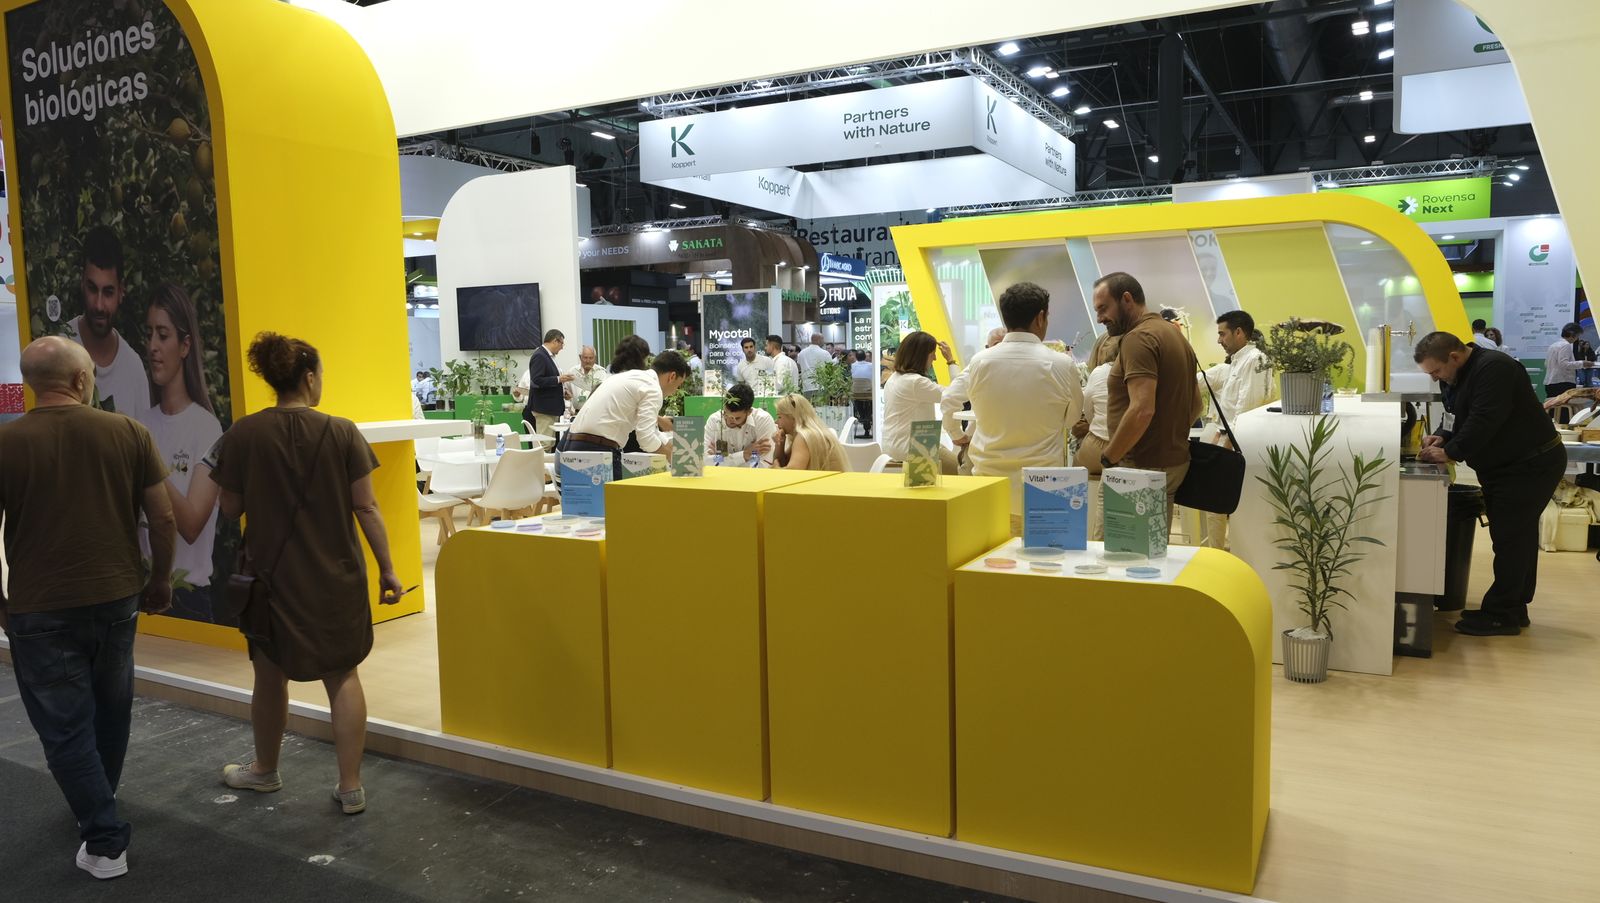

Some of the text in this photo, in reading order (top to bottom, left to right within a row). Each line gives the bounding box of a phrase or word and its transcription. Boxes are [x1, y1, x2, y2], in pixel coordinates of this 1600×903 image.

[22, 21, 156, 82] Soluciones
[25, 72, 148, 126] biológicas
[843, 107, 909, 124] Partners
[843, 120, 931, 140] with Nature
[671, 160, 696, 169] Koppert
[758, 175, 791, 197] Koppert
[1422, 193, 1476, 204] Rovensa
[1422, 204, 1454, 214] Next
[796, 223, 895, 246] Restaura
[681, 238, 723, 250] SAKATA
[583, 248, 600, 259] your
[601, 246, 629, 256] NEEDS
[828, 286, 857, 302] FRUTA
[819, 307, 841, 315] LUTIONS
[709, 327, 752, 341] Mycotal
[854, 325, 872, 333] estr
